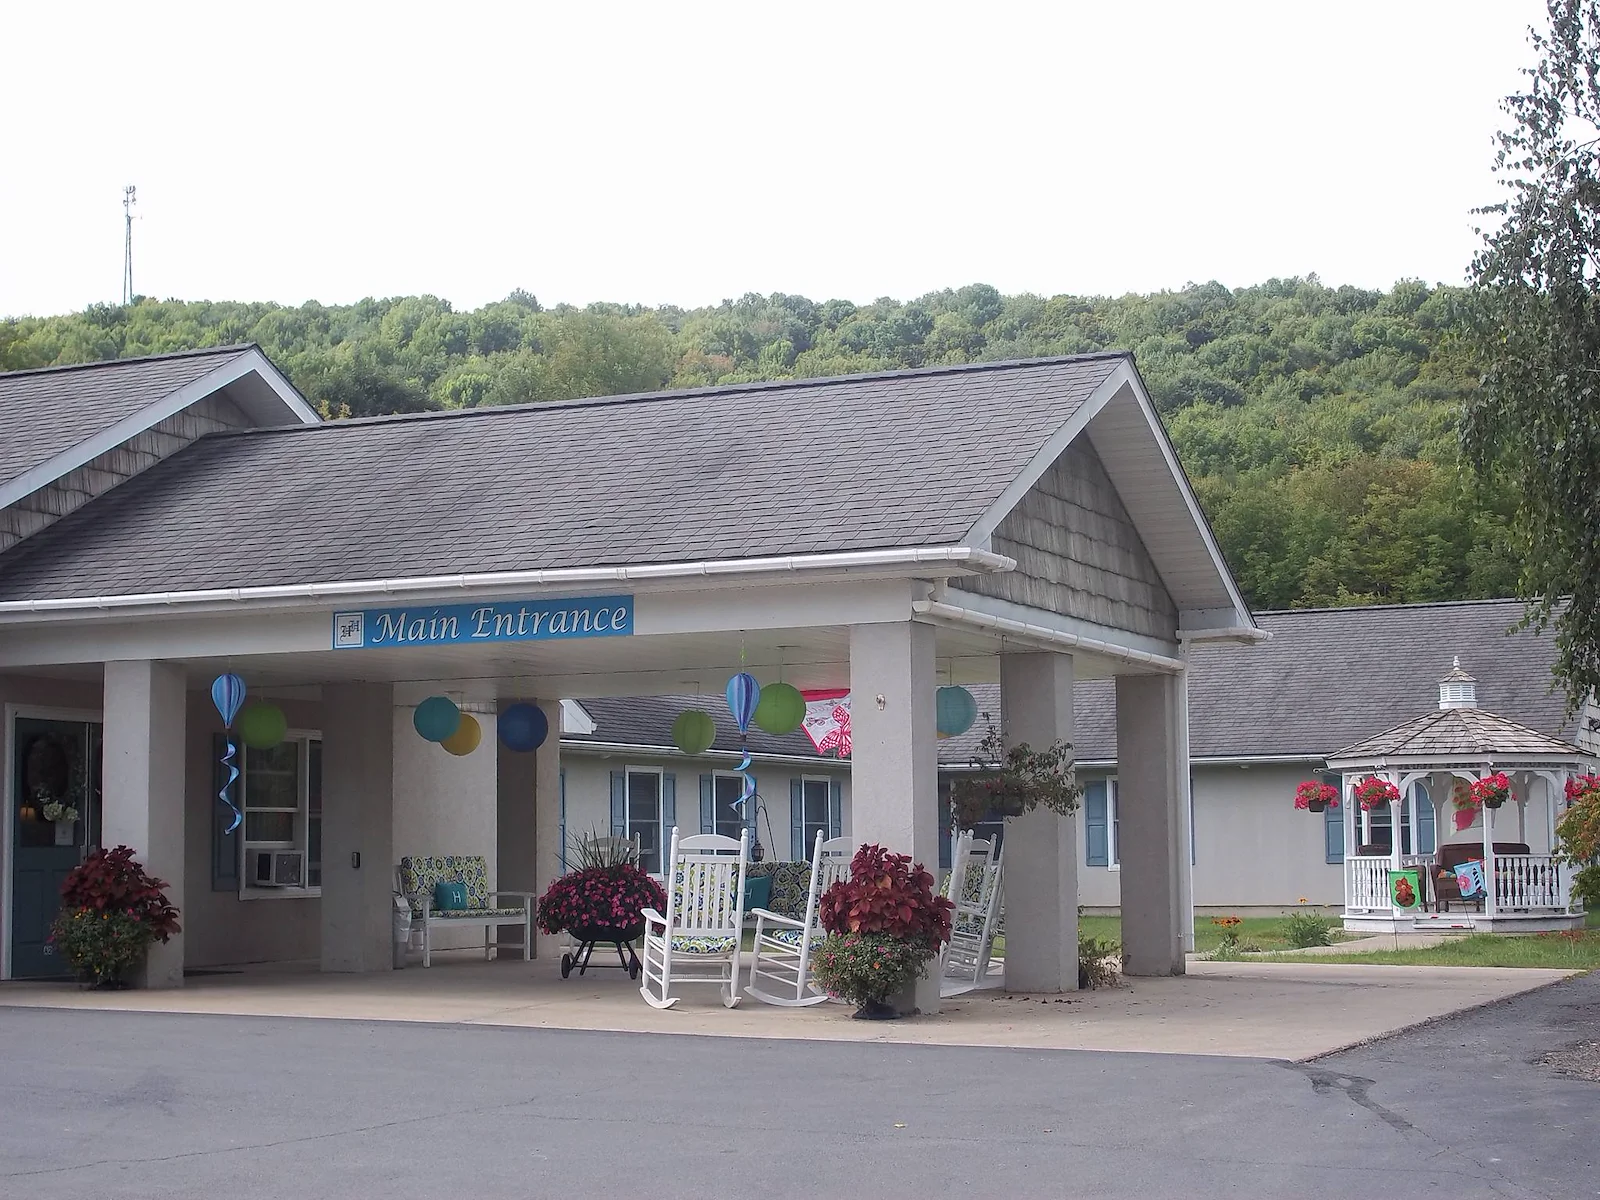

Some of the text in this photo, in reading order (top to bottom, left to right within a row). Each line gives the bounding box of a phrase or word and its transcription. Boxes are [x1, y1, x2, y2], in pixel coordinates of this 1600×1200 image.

[372, 606, 627, 643] Main Entrance
[452, 890, 462, 903] H
